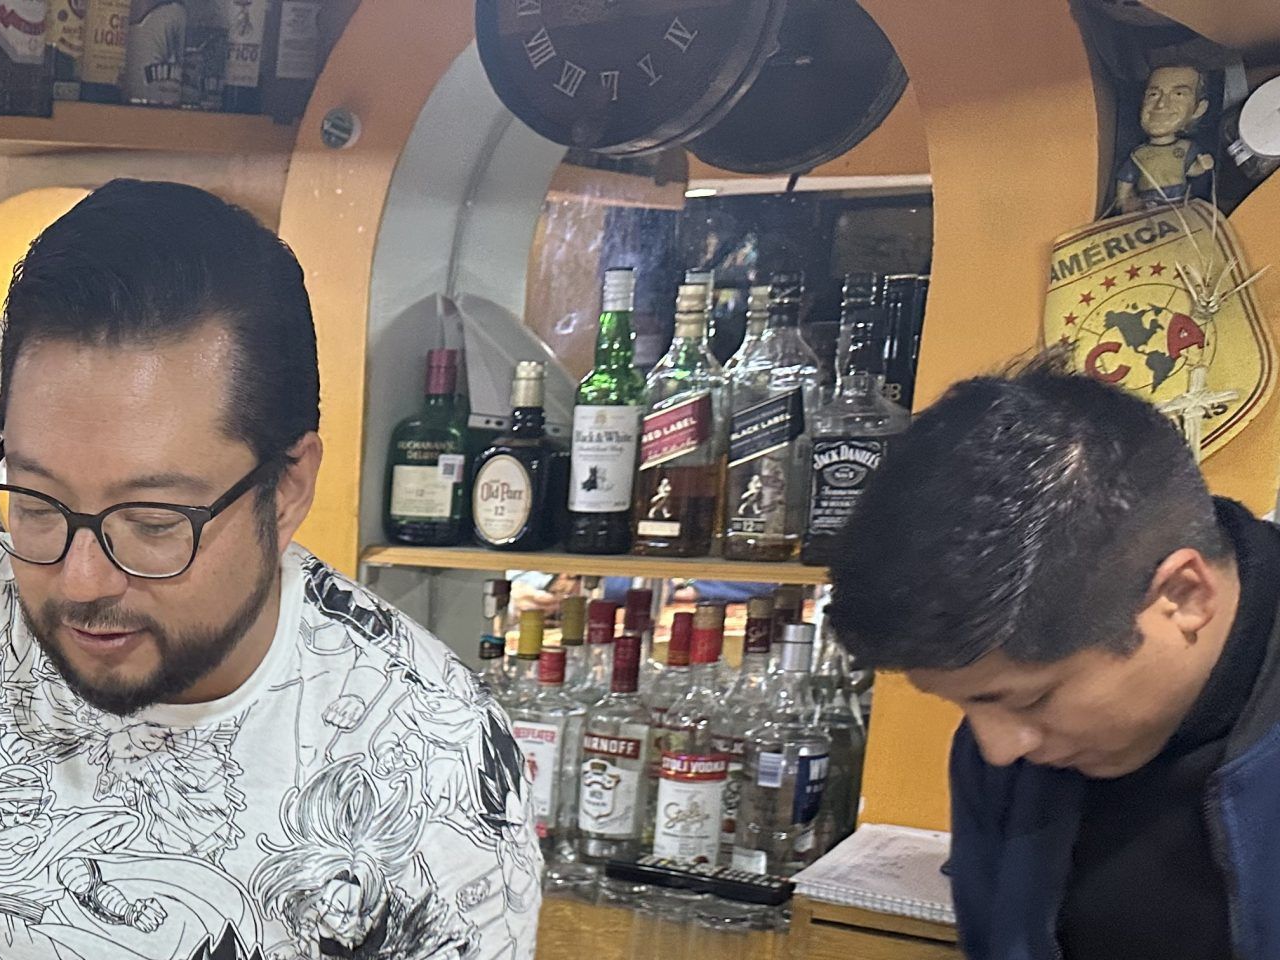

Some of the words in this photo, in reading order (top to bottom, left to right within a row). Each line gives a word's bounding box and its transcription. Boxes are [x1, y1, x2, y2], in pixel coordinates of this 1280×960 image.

[522, 27, 557, 70] VIII
[553, 60, 587, 97] VII
[636, 53, 663, 87] V
[662, 416, 698, 433] LABEL
[729, 421, 761, 441] BLACK
[761, 412, 792, 429] LABEL
[813, 449, 840, 470] JACK
[480, 481, 499, 501] Old
[500, 481, 524, 501] Parr
[493, 506, 506, 517] 12
[583, 735, 635, 754] IRNOFF
